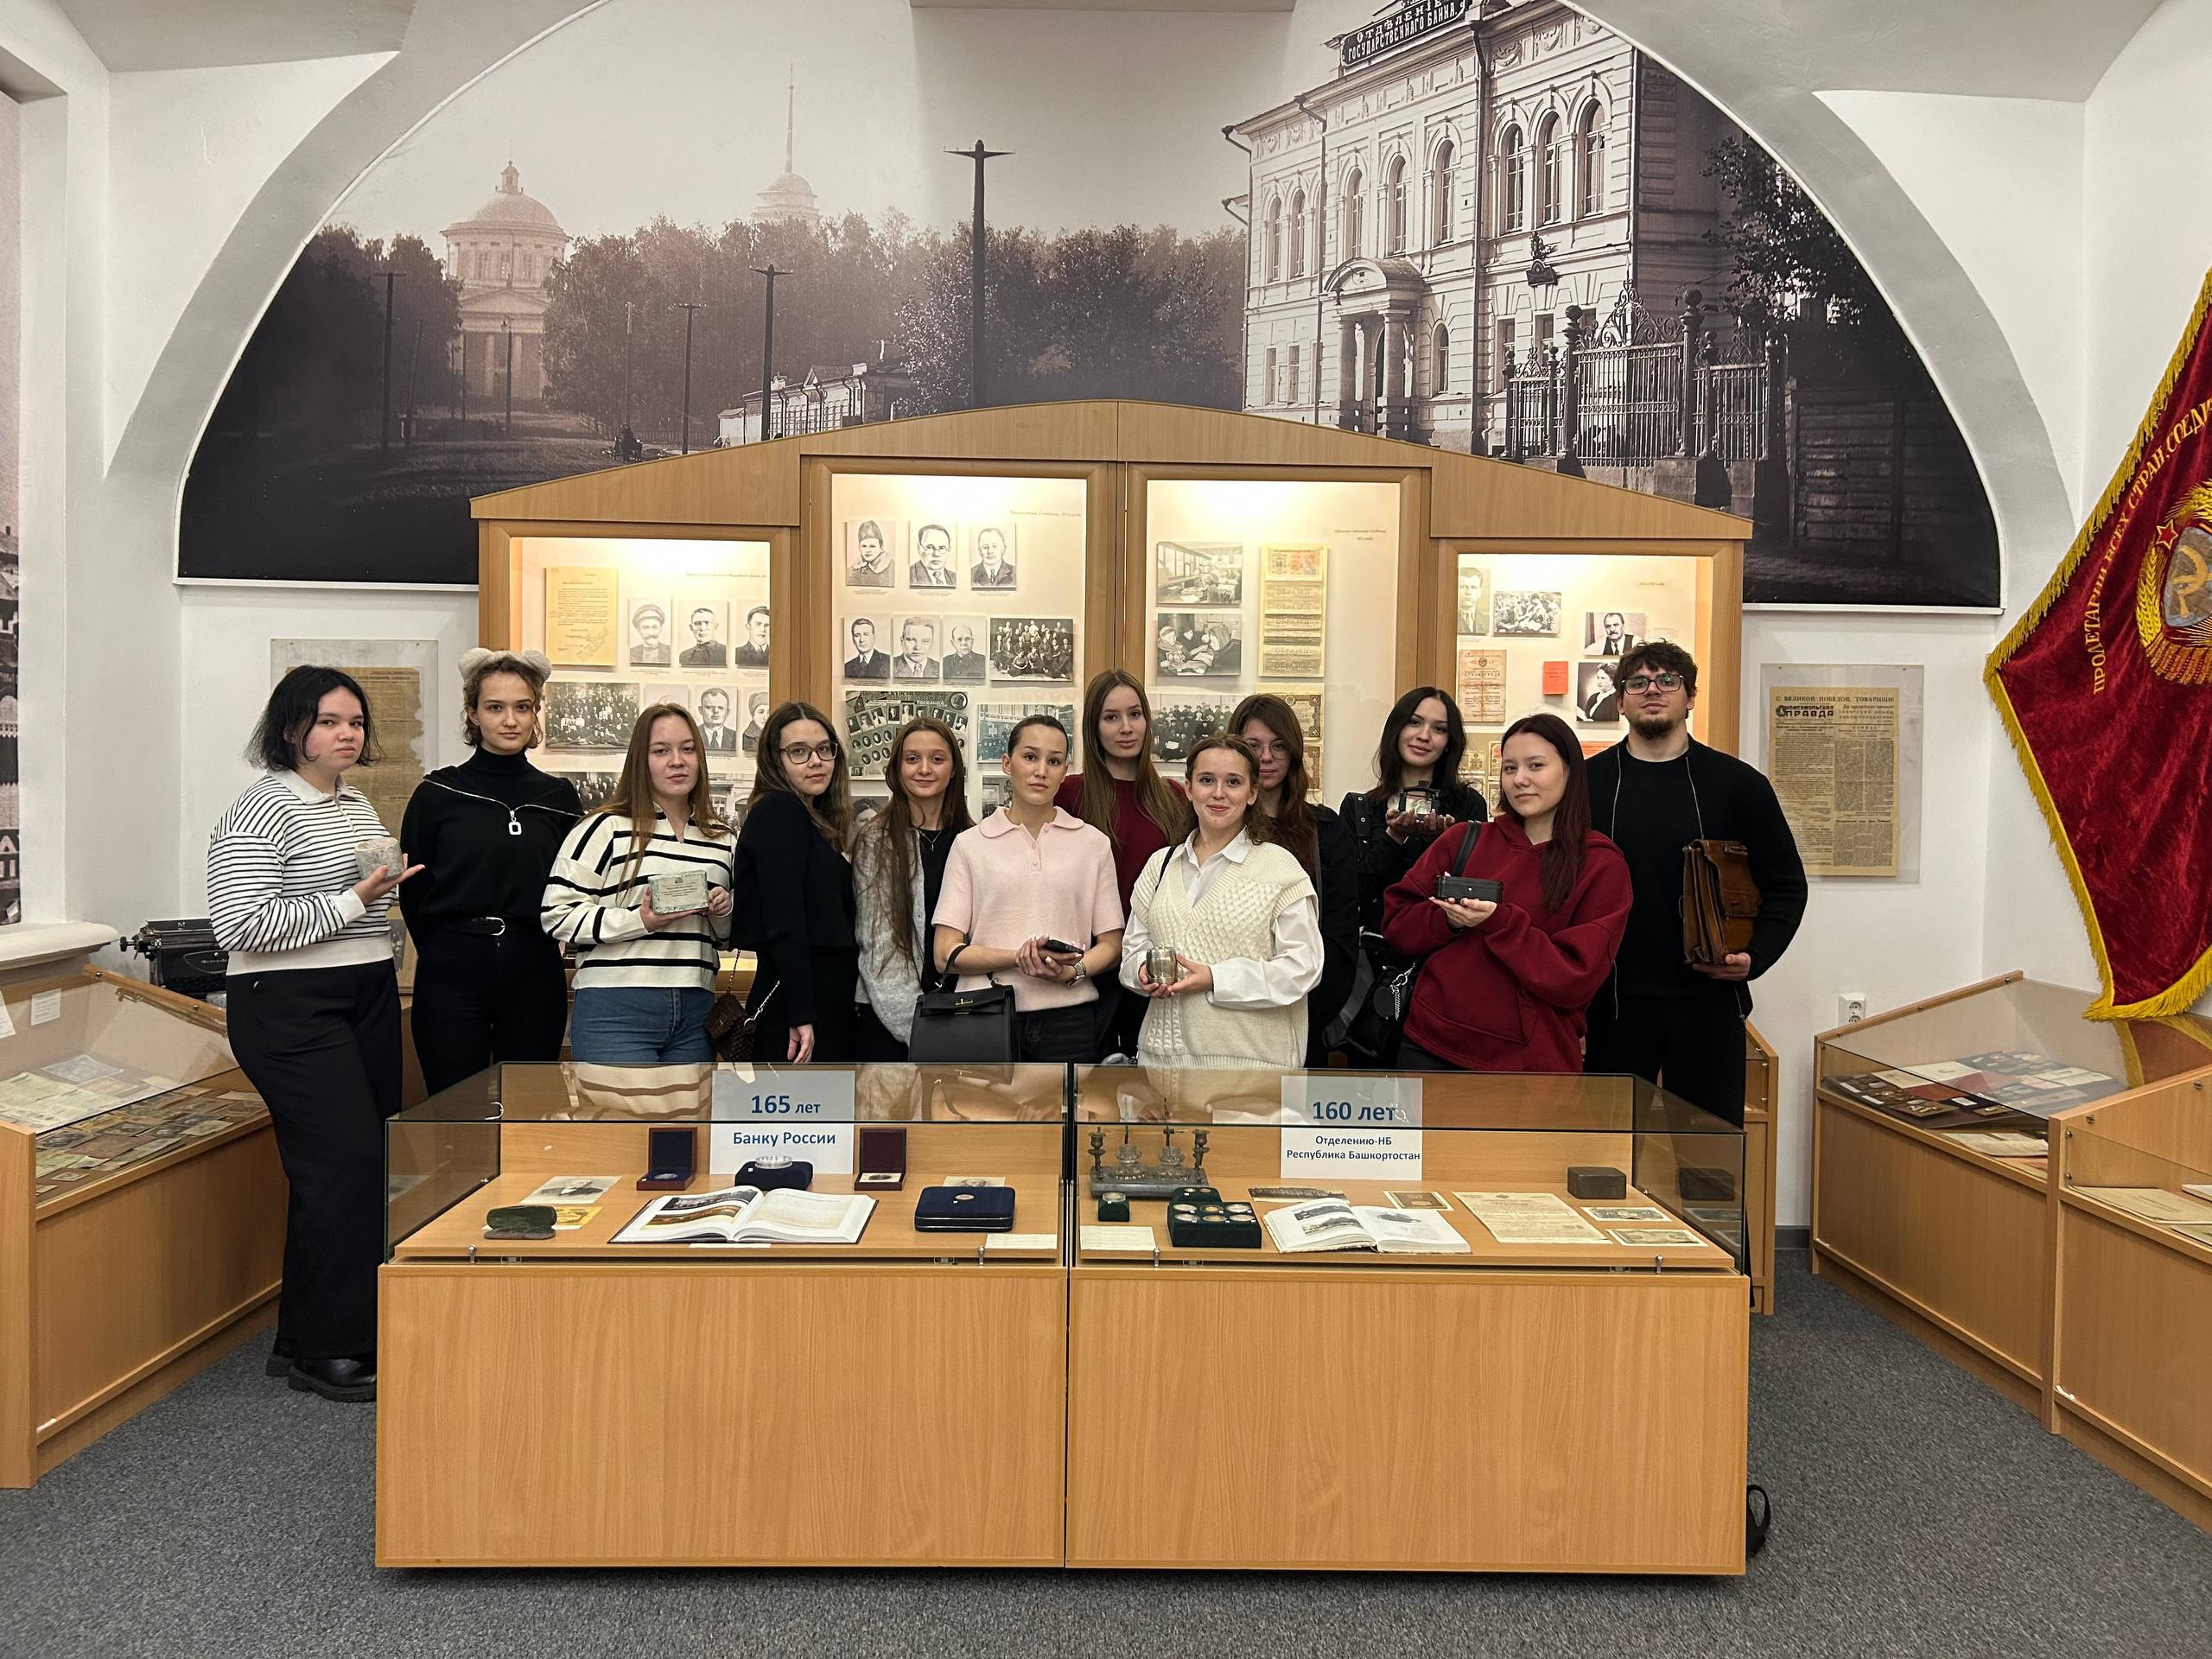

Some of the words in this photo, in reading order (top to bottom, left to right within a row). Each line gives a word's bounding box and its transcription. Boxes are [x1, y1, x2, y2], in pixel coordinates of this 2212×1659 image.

[1348, 19, 1425, 61] ГОСУДАРСТВЕННАГО
[2084, 567, 2107, 695] ПРОЛЕТАРИИ
[2104, 512, 2130, 563] ВСЕХ
[1785, 710, 1834, 719] ПРАВДА
[751, 1095, 791, 1114] 165
[795, 1103, 821, 1114] лет
[1313, 1101, 1352, 1121] 160
[1357, 1106, 1397, 1121] лет
[733, 1132, 779, 1147] Банку
[783, 1132, 836, 1145] России
[1315, 1135, 1392, 1147] Отделению-НБ
[1287, 1149, 1345, 1160] Республика
[1349, 1150, 1421, 1161] Башкортостан
